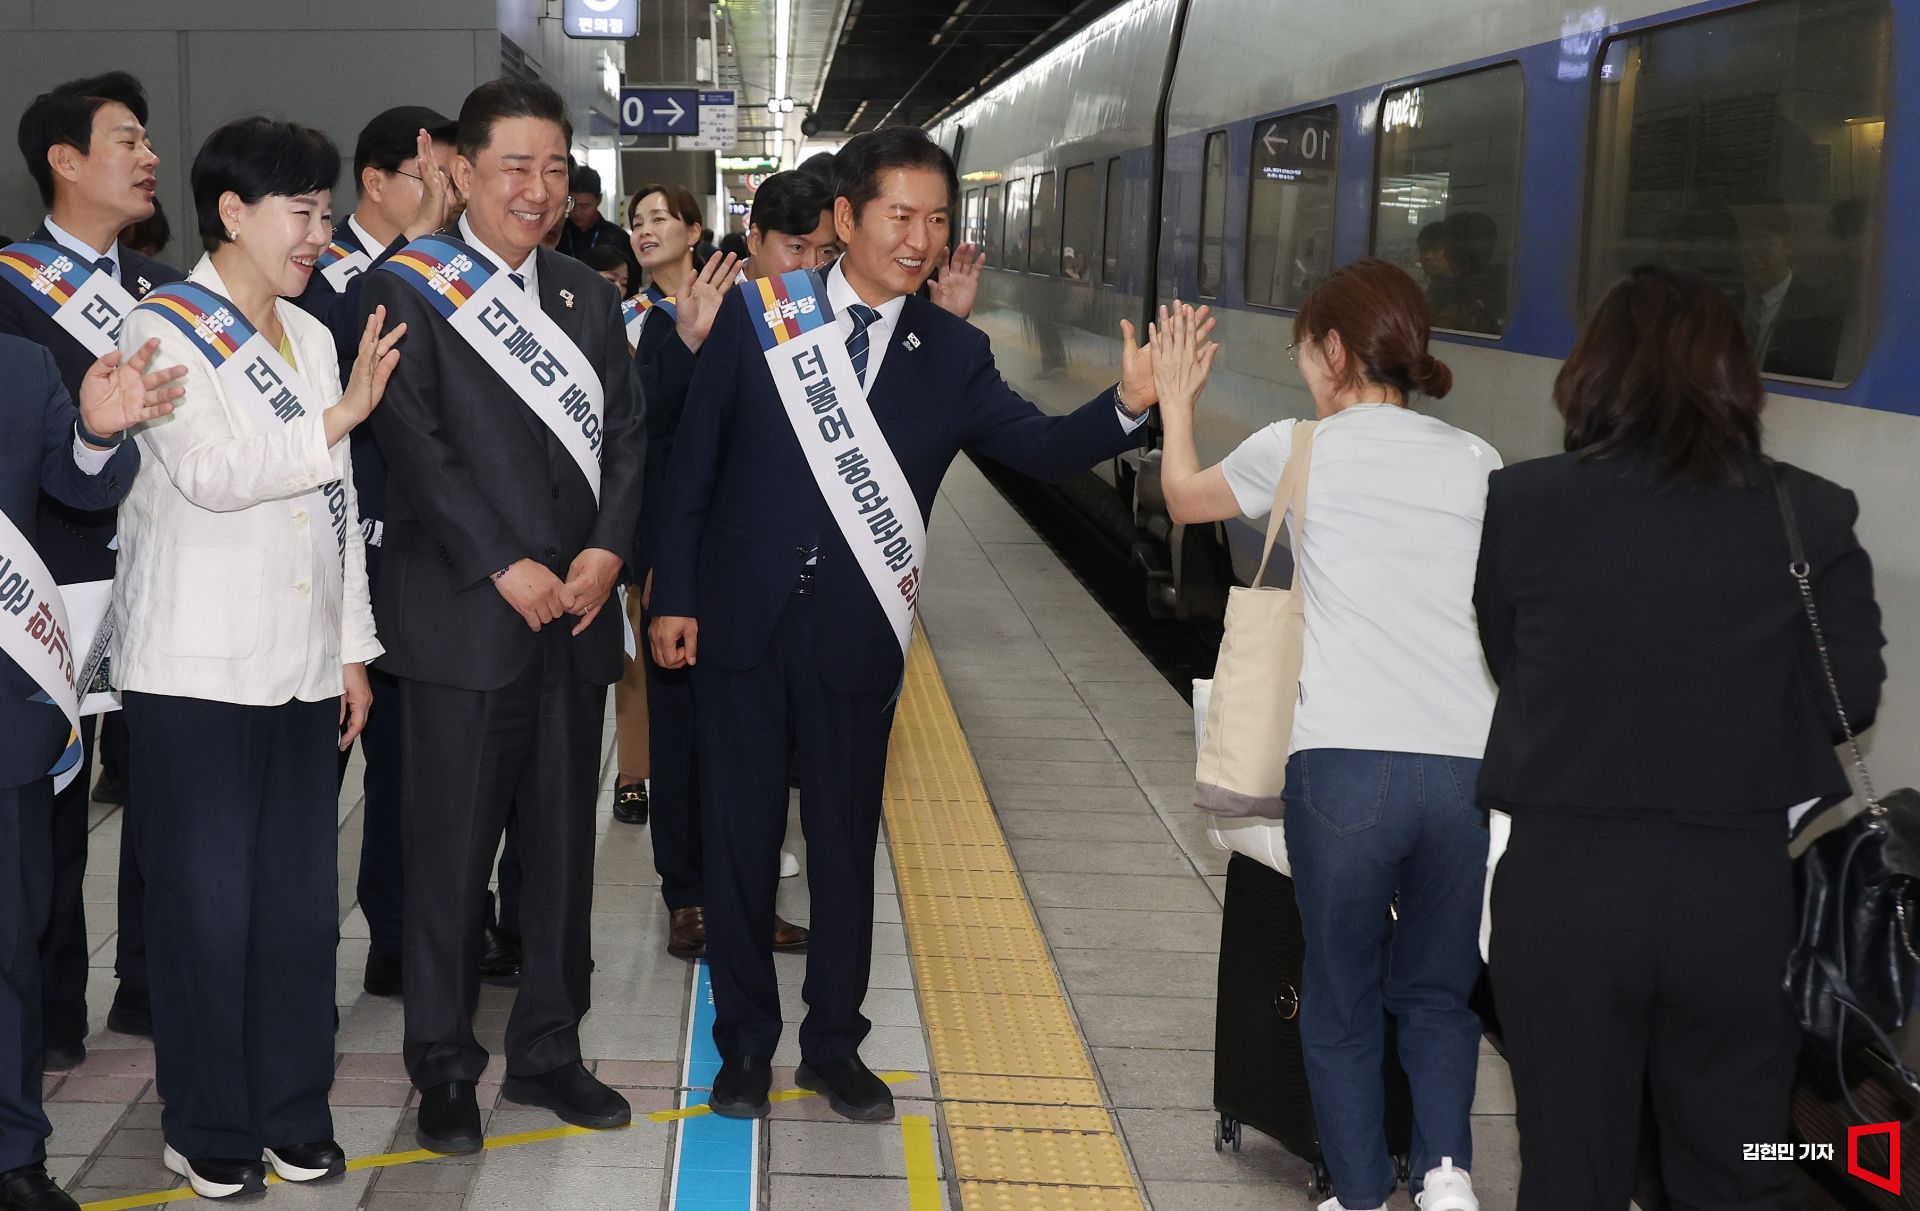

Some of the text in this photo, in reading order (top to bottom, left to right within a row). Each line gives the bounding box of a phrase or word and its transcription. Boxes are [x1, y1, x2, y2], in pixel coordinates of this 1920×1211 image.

[577, 17, 624, 33] 편의점
[30, 255, 74, 295] 민주당
[427, 253, 473, 296] 민주당
[195, 307, 235, 345] 민주당
[763, 295, 816, 329] 민주당
[477, 297, 603, 462] 더불어 풍요
[791, 344, 854, 443] 더불어
[834, 446, 912, 572] 풍요로운
